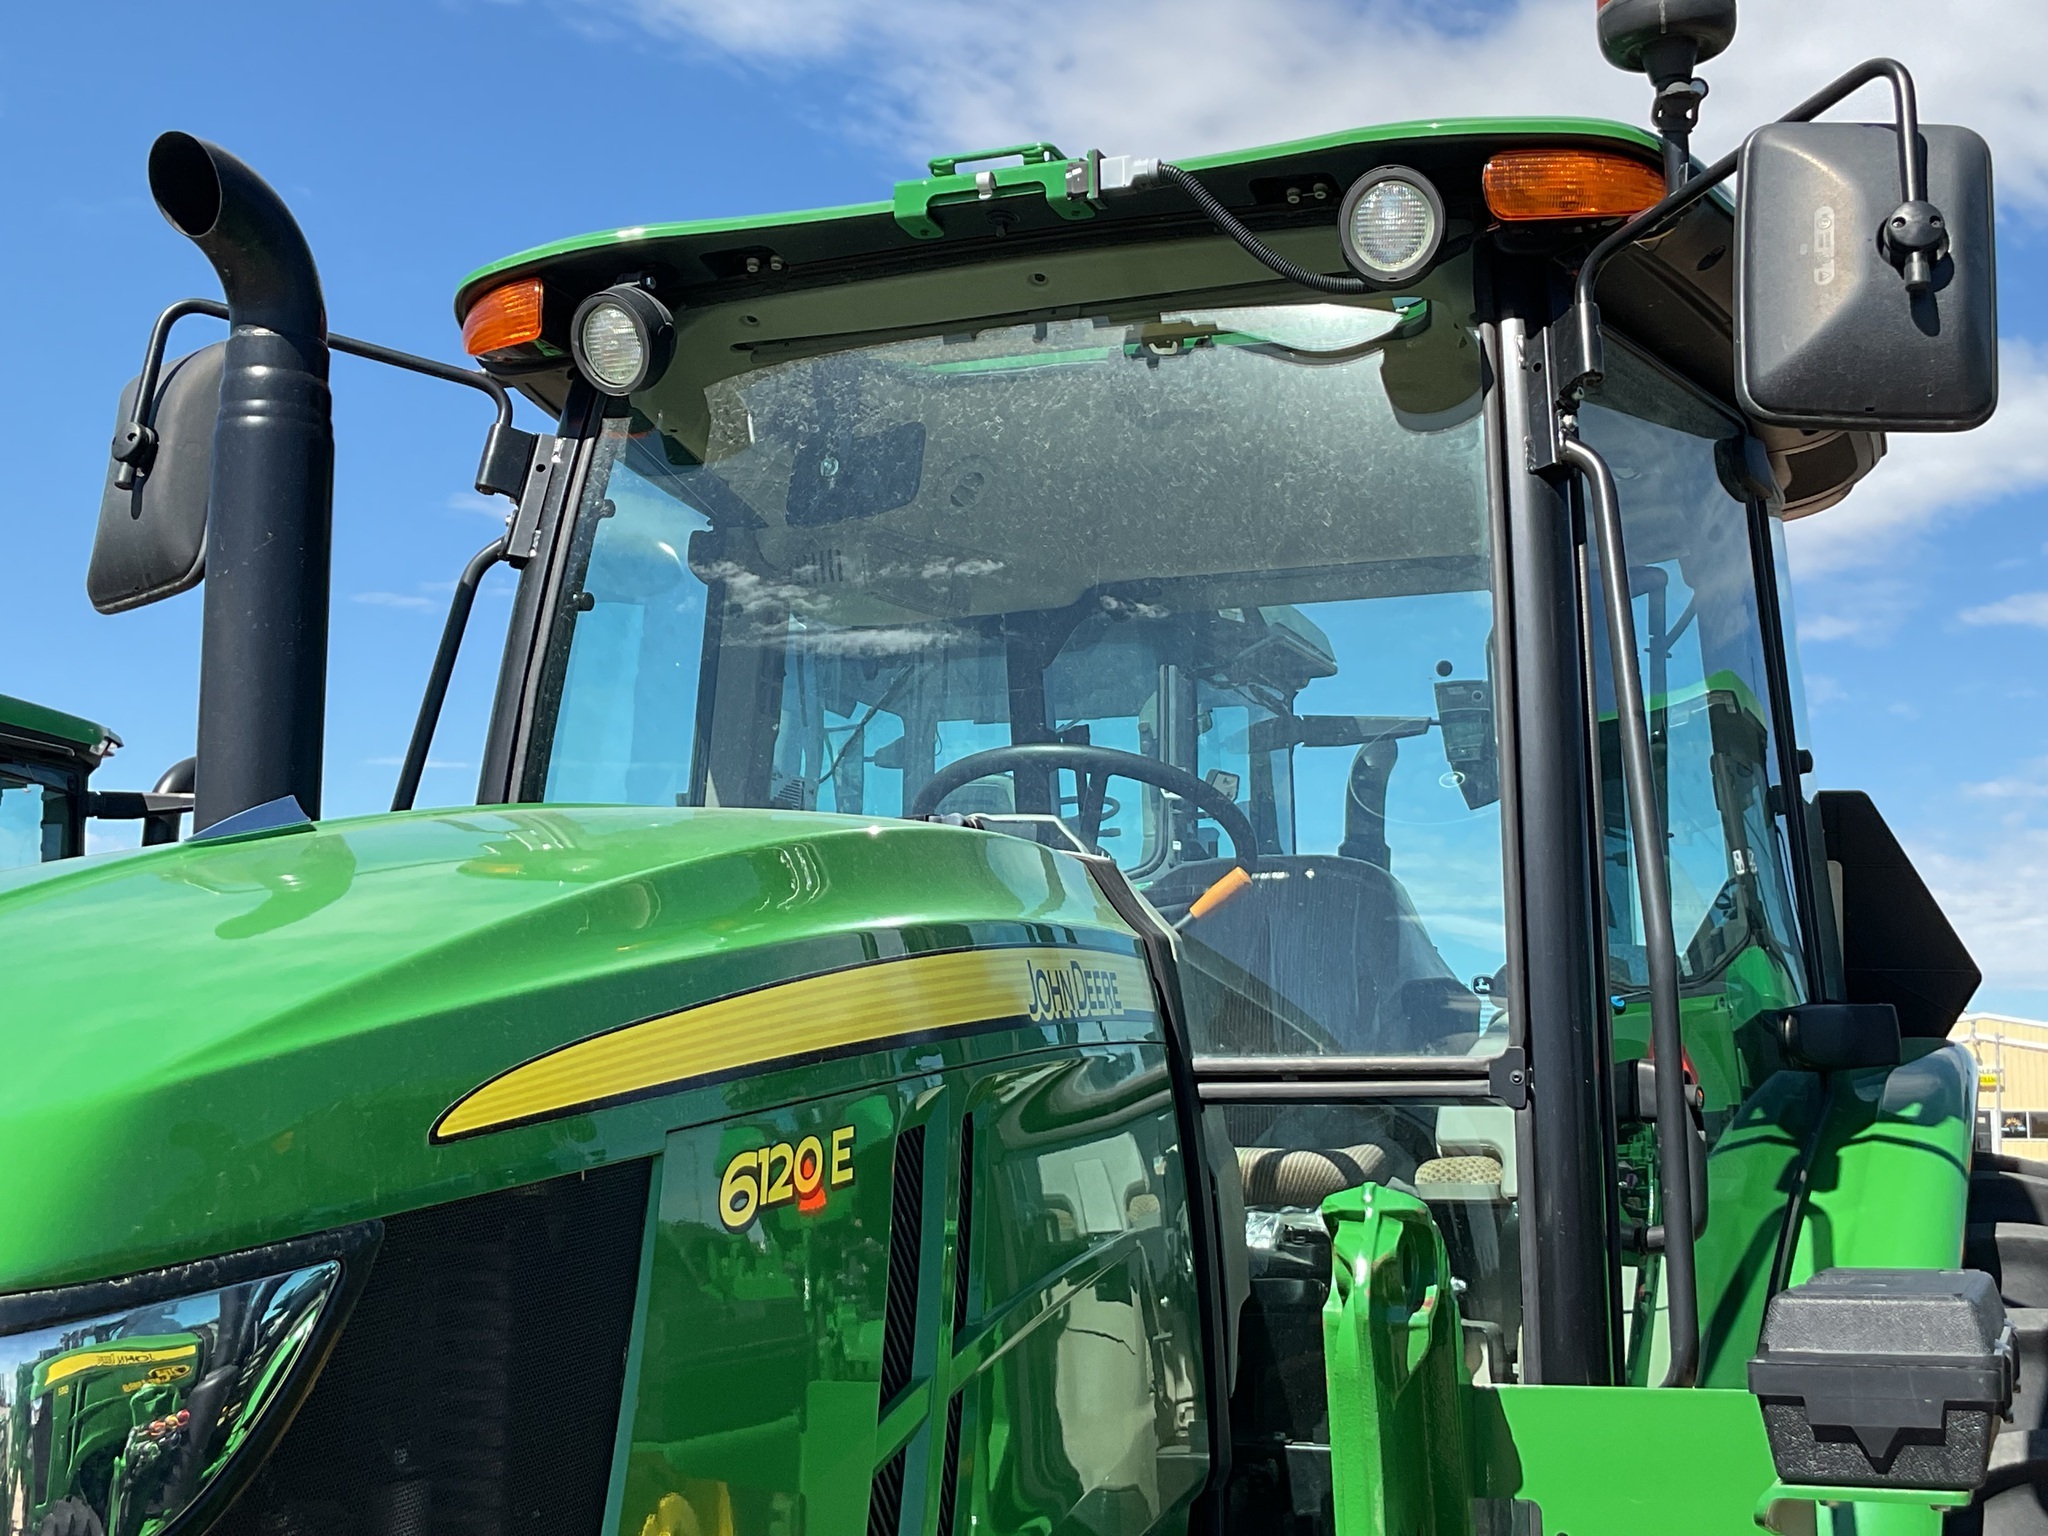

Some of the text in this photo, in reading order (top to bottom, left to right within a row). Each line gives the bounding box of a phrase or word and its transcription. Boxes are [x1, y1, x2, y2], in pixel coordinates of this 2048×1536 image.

[1027, 958, 1122, 1016] JOHN DEERE
[719, 1125, 855, 1229] 6120 E
